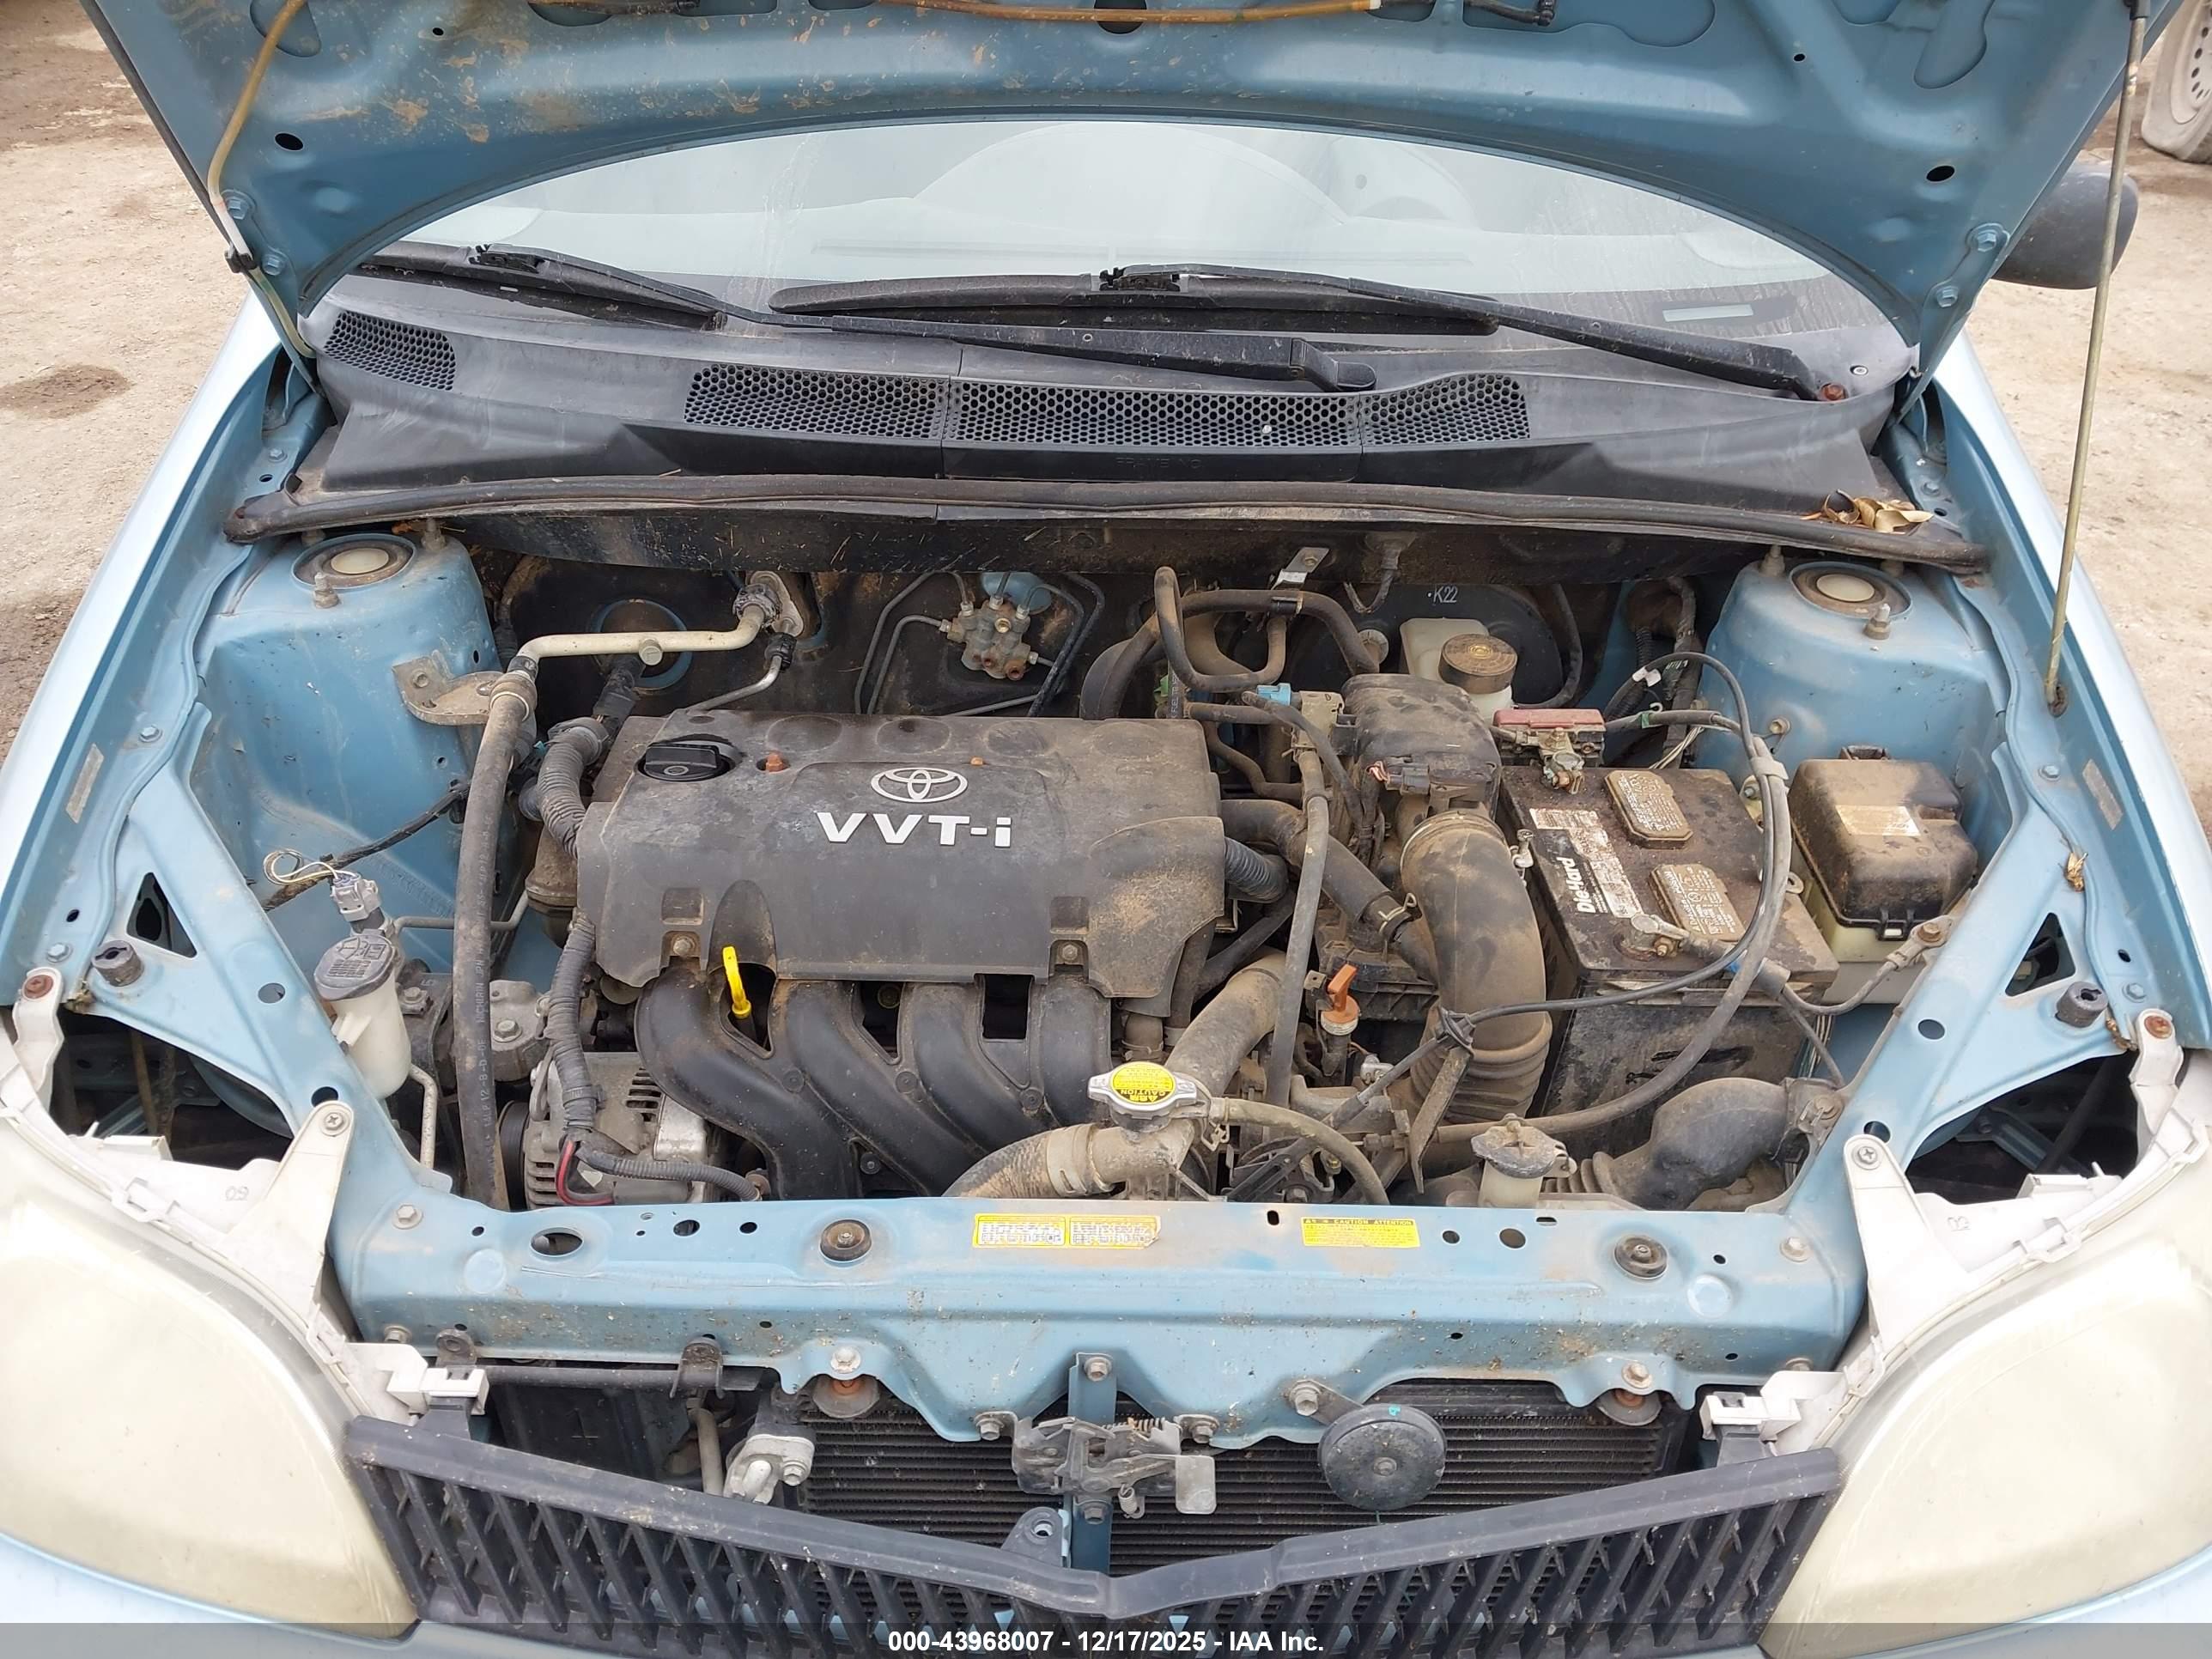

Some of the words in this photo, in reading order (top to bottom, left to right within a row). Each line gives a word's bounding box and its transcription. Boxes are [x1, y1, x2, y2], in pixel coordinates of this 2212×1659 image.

[1433, 586, 1458, 603] K22
[817, 811, 1012, 848] VVT-i
[1556, 856, 1597, 914] DieHard
